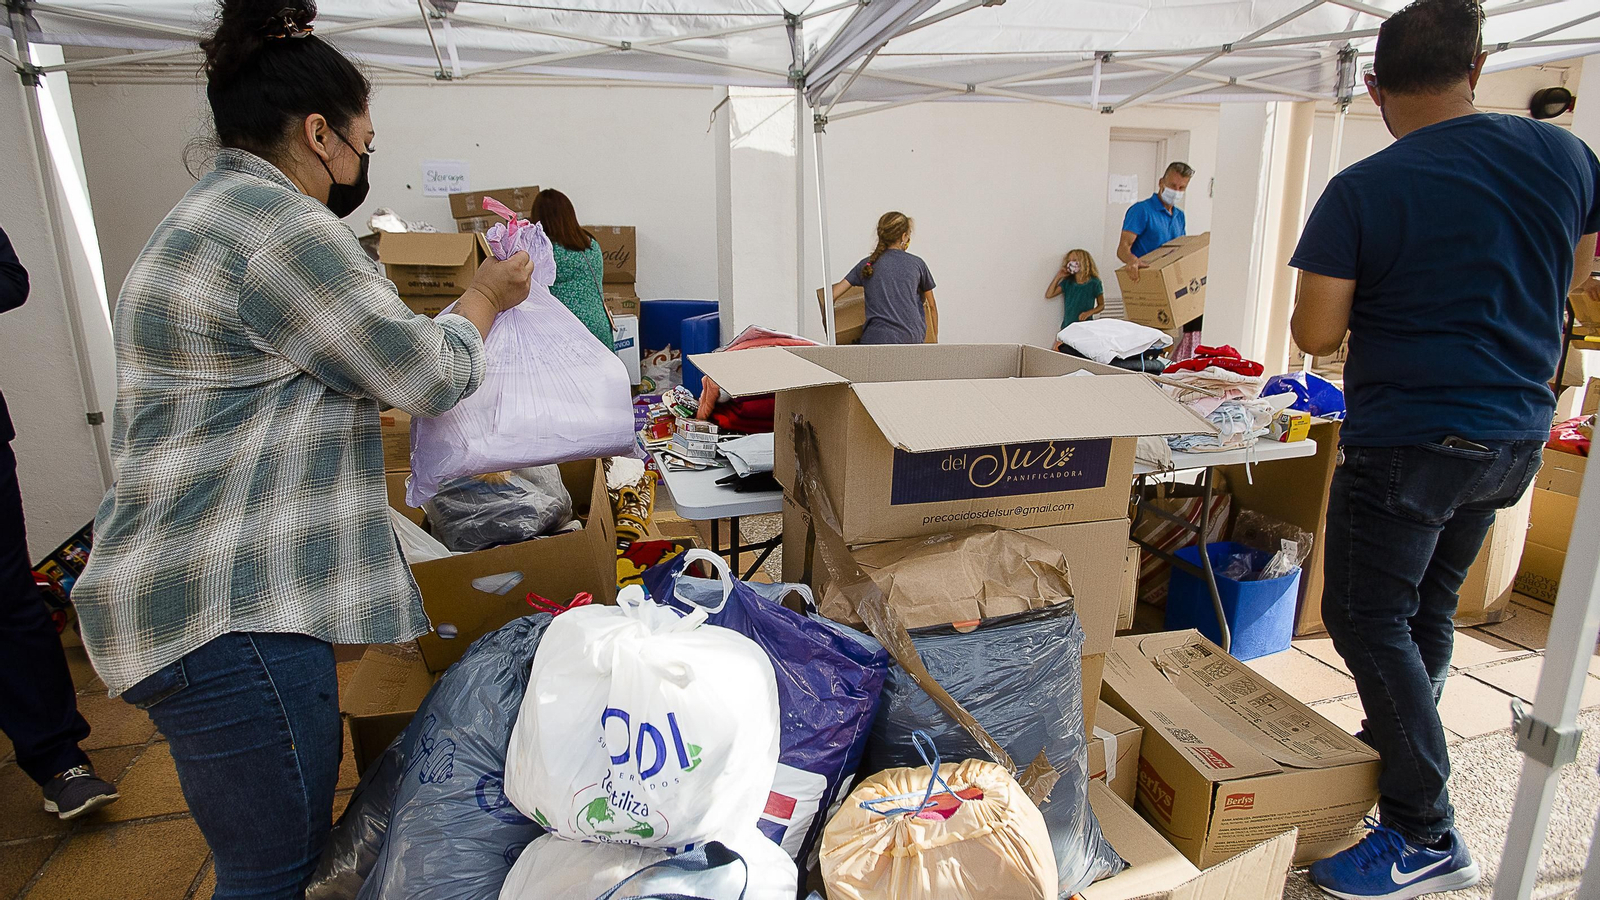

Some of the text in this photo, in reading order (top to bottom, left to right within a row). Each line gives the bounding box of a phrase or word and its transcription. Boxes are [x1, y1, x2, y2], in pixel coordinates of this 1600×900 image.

[426, 169, 464, 185] Storage
[602, 245, 630, 268] ody
[614, 340, 630, 348] ervicio
[941, 441, 1059, 488] del Sur
[1006, 470, 1083, 483] PANIFICADORA
[922, 502, 1075, 526] precocidosdelsur@gmail.com
[1513, 580, 1538, 594] CACA
[1140, 771, 1172, 806] erlys
[1226, 796, 1254, 808] Berlys
